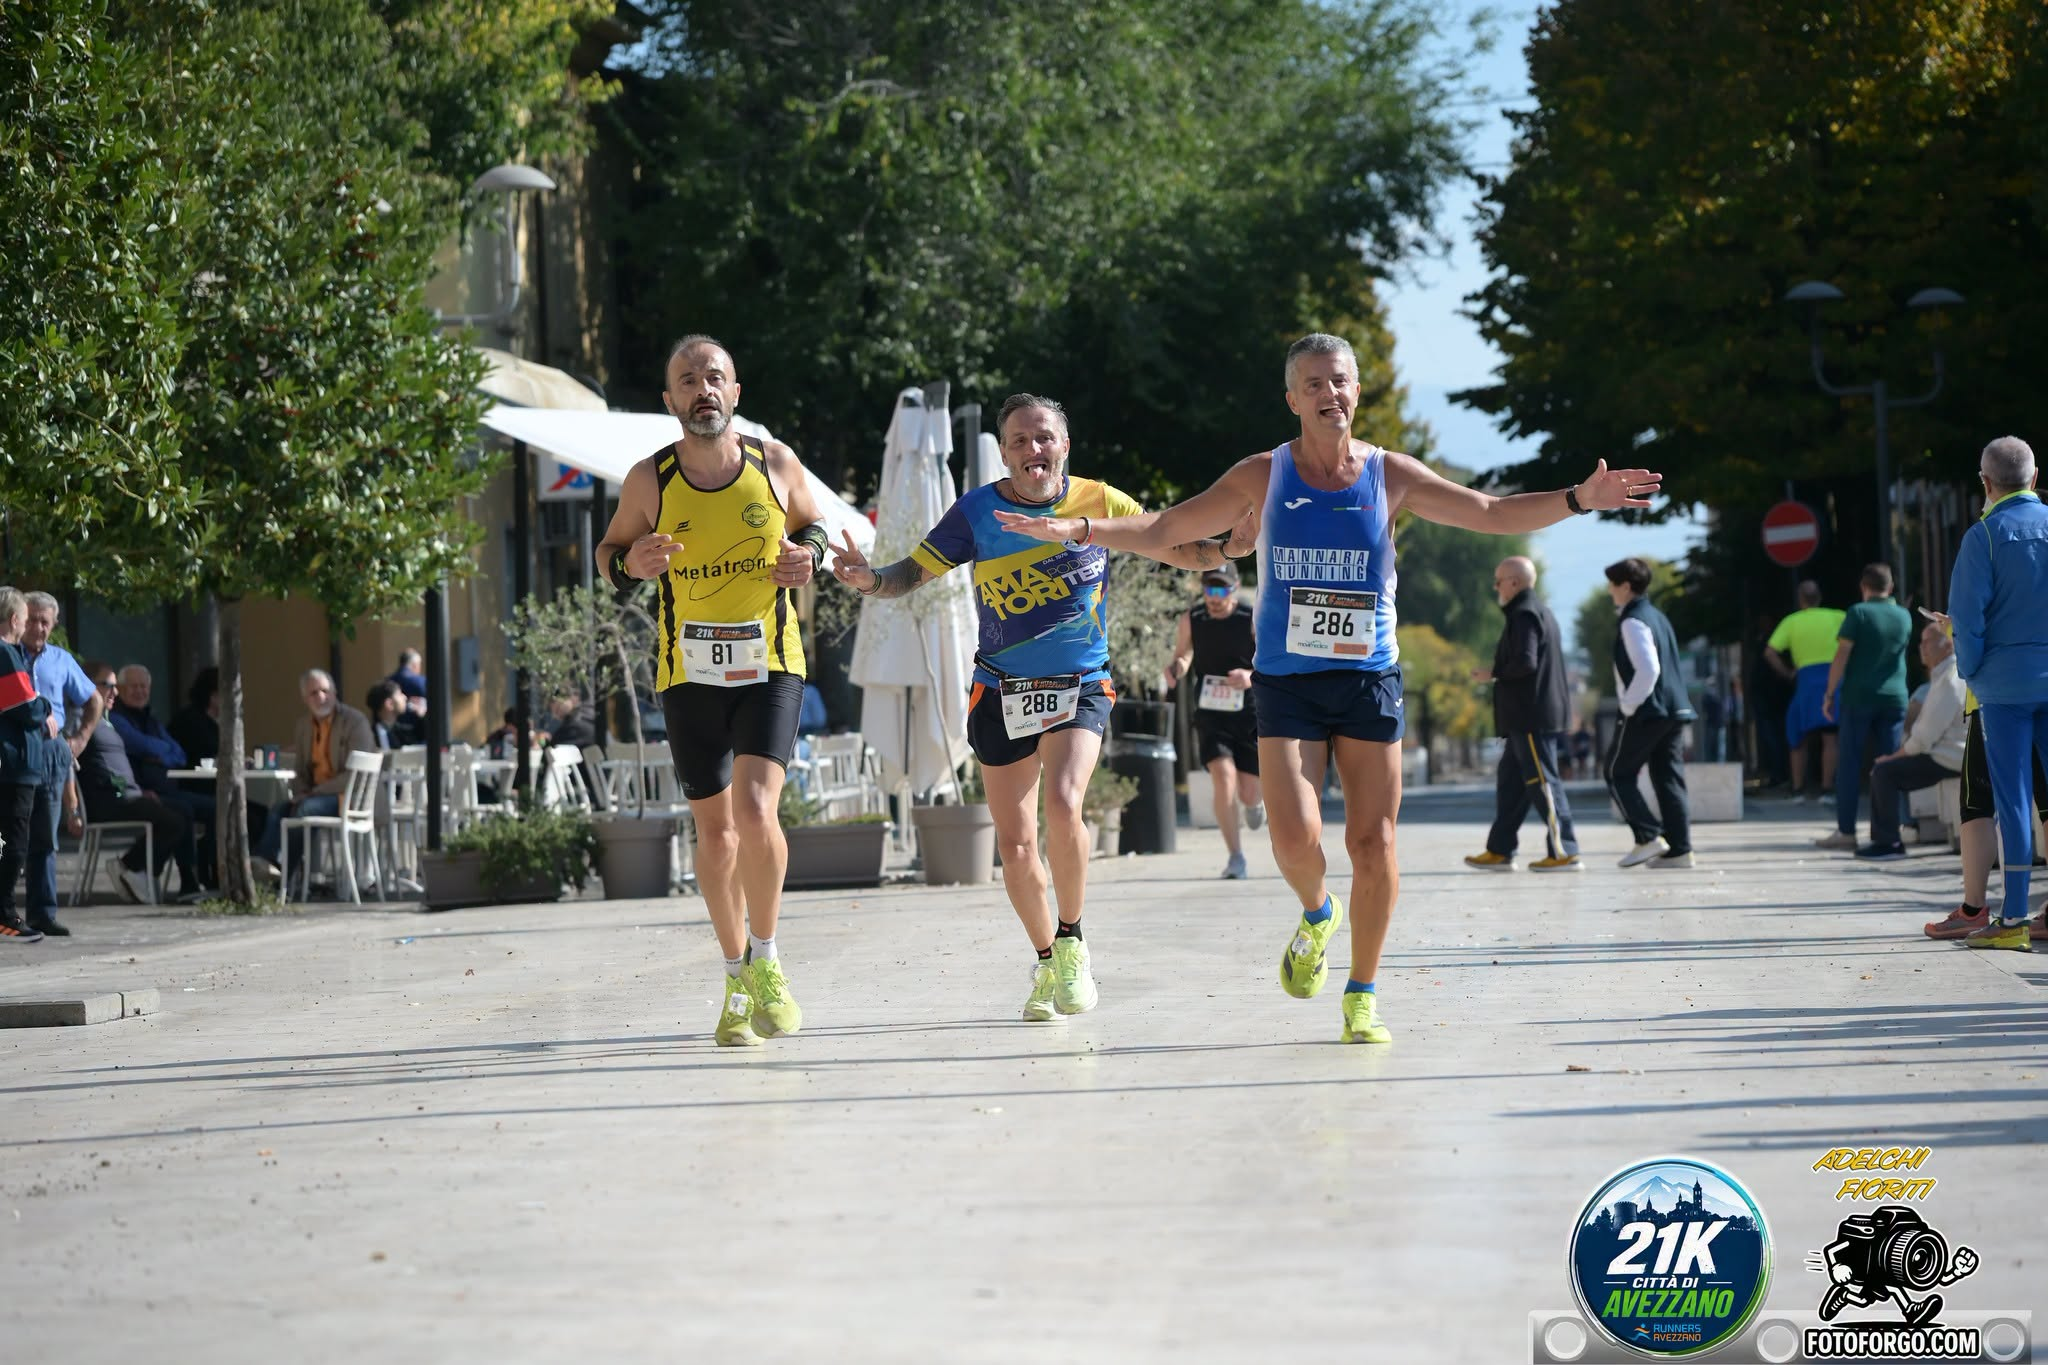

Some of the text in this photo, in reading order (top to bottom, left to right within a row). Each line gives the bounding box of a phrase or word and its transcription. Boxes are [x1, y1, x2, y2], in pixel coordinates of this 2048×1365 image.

[1274, 549, 1365, 565] MANNARA
[674, 557, 766, 580] Metatron
[1276, 565, 1365, 580] RUNNING
[981, 566, 1053, 606] AMA
[988, 576, 1071, 621] TORI
[1305, 593, 1328, 605] 21K
[696, 628, 714, 638] 21K
[1312, 611, 1354, 637] 286
[711, 643, 732, 665] 81
[1015, 681, 1033, 692] 21K
[1021, 693, 1058, 716] 288
